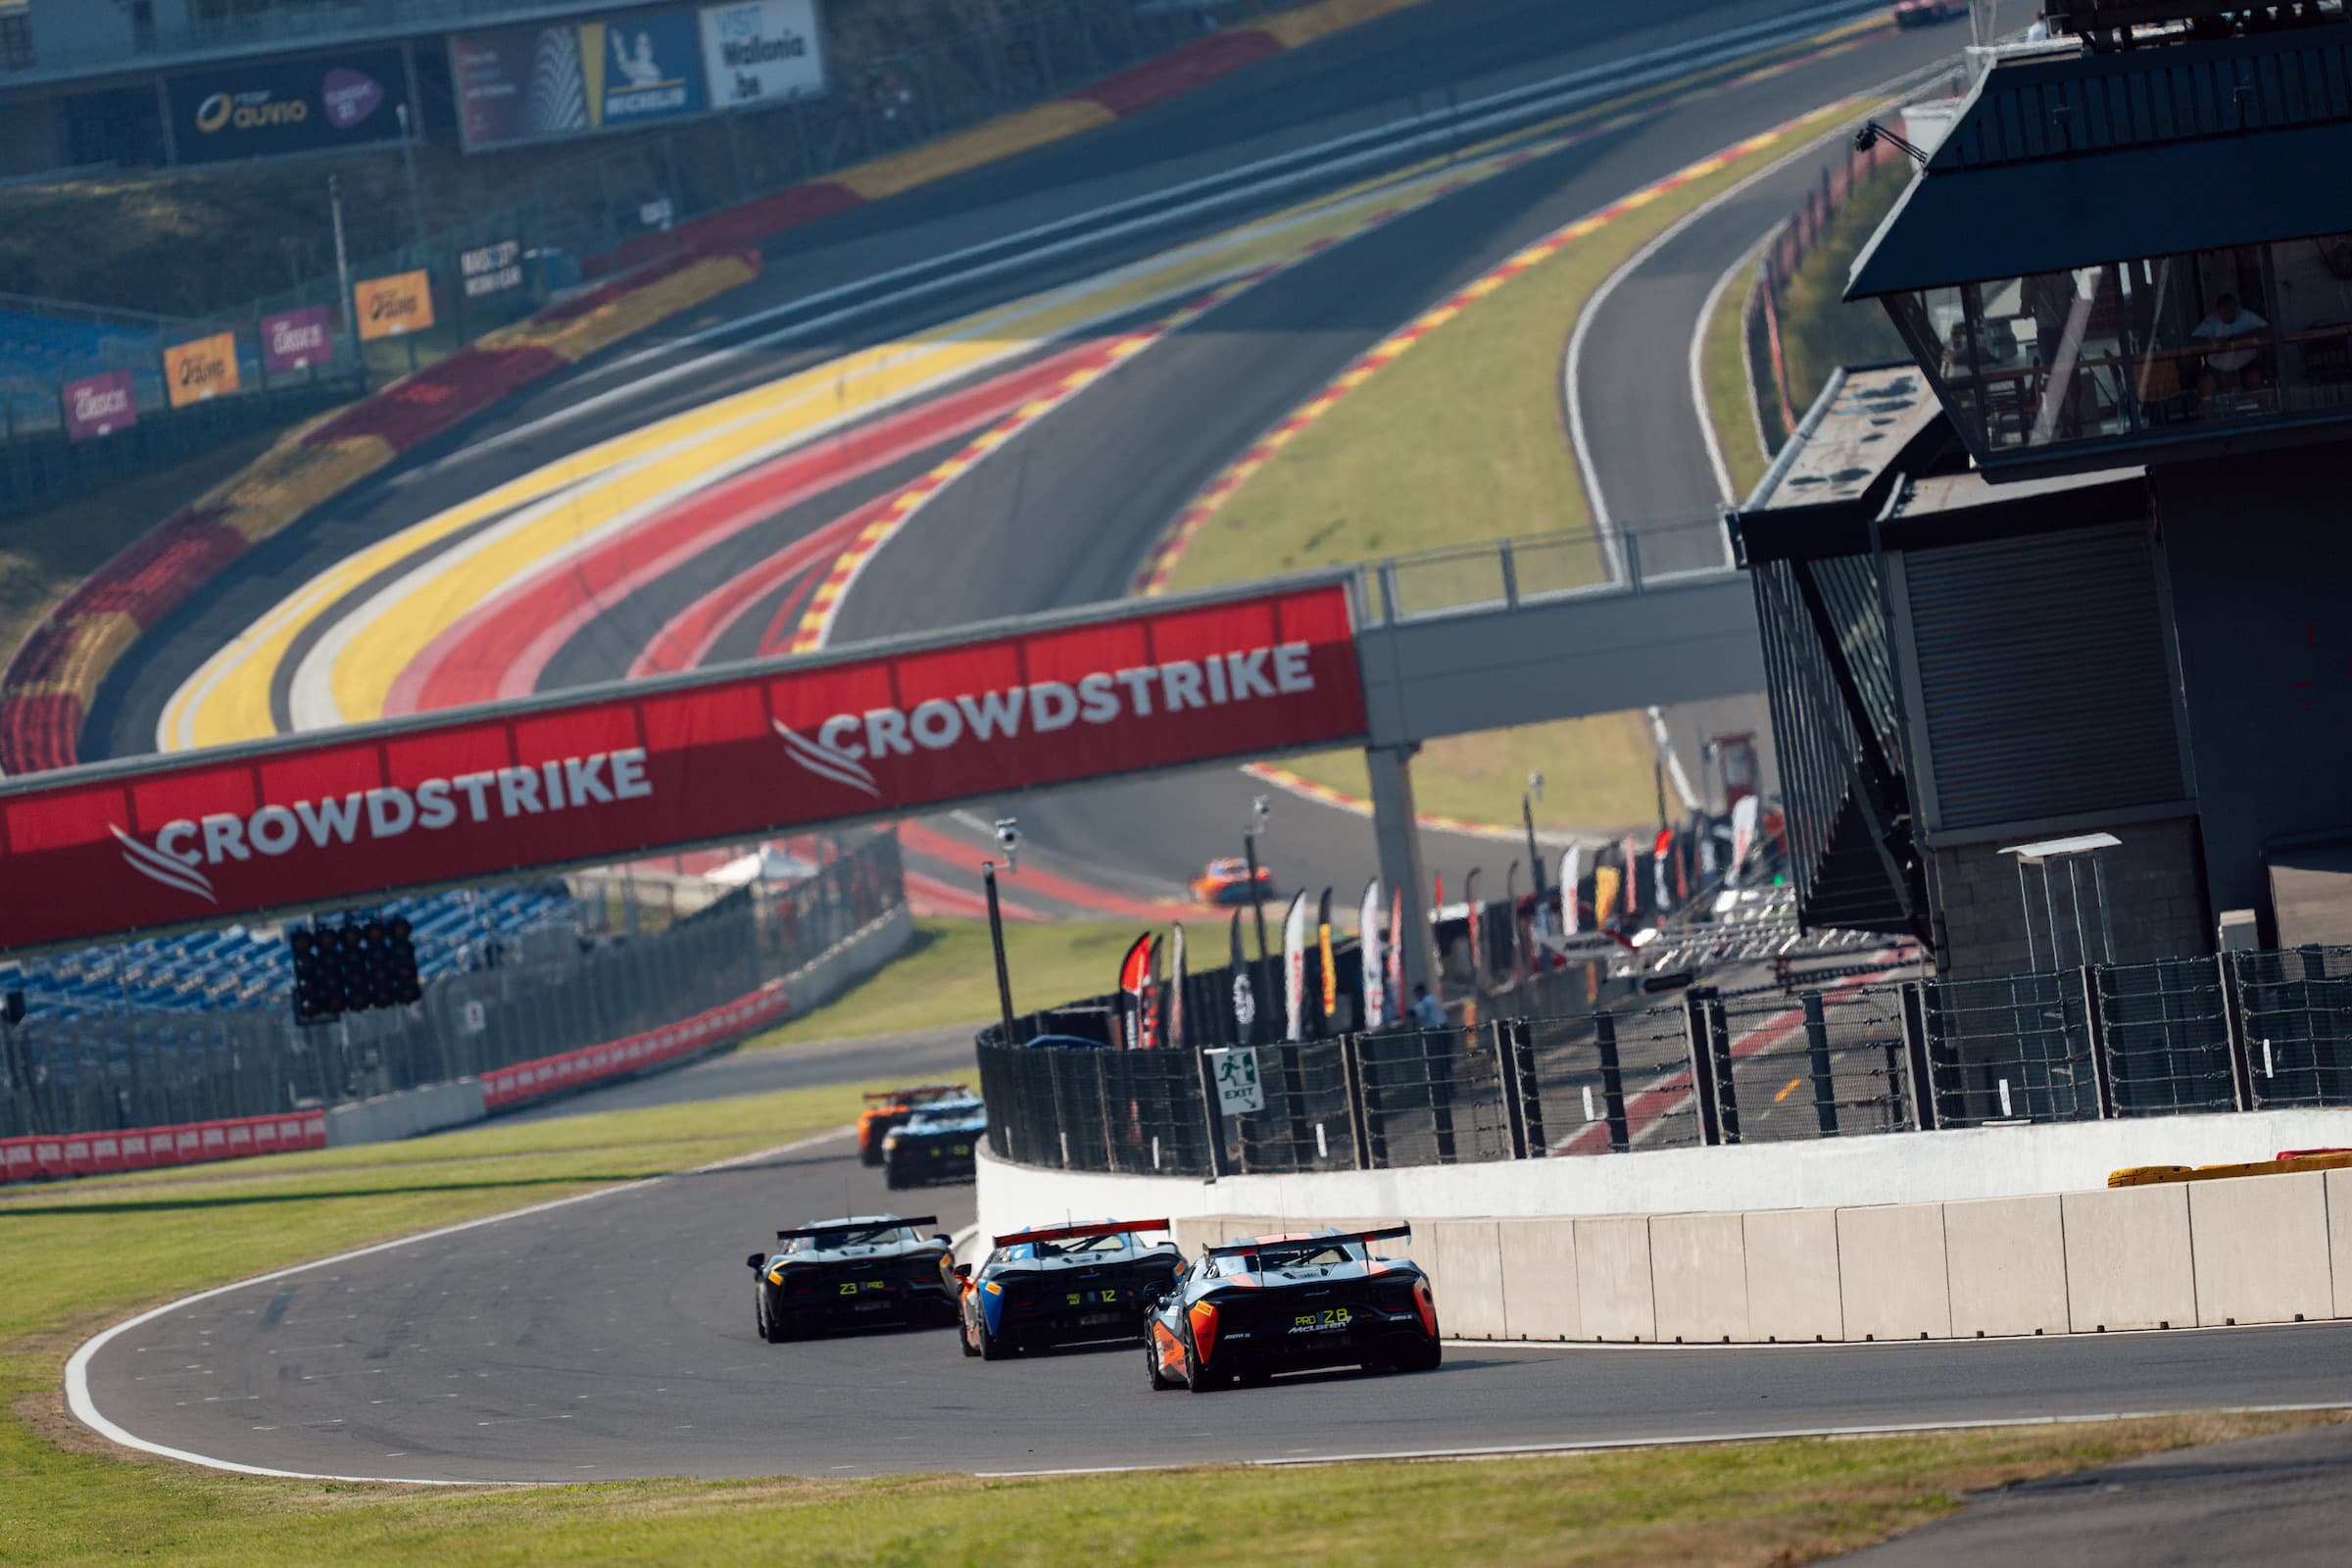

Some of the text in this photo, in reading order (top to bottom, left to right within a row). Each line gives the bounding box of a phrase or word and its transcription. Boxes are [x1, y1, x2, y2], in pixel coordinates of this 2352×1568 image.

[817, 640, 1315, 762] CROWDSTRIKE
[156, 746, 653, 867] CROWDSTRIKE
[1224, 1087, 1254, 1100] EXIT
[839, 1282, 858, 1296] 23
[1295, 1315, 1316, 1326] PRO
